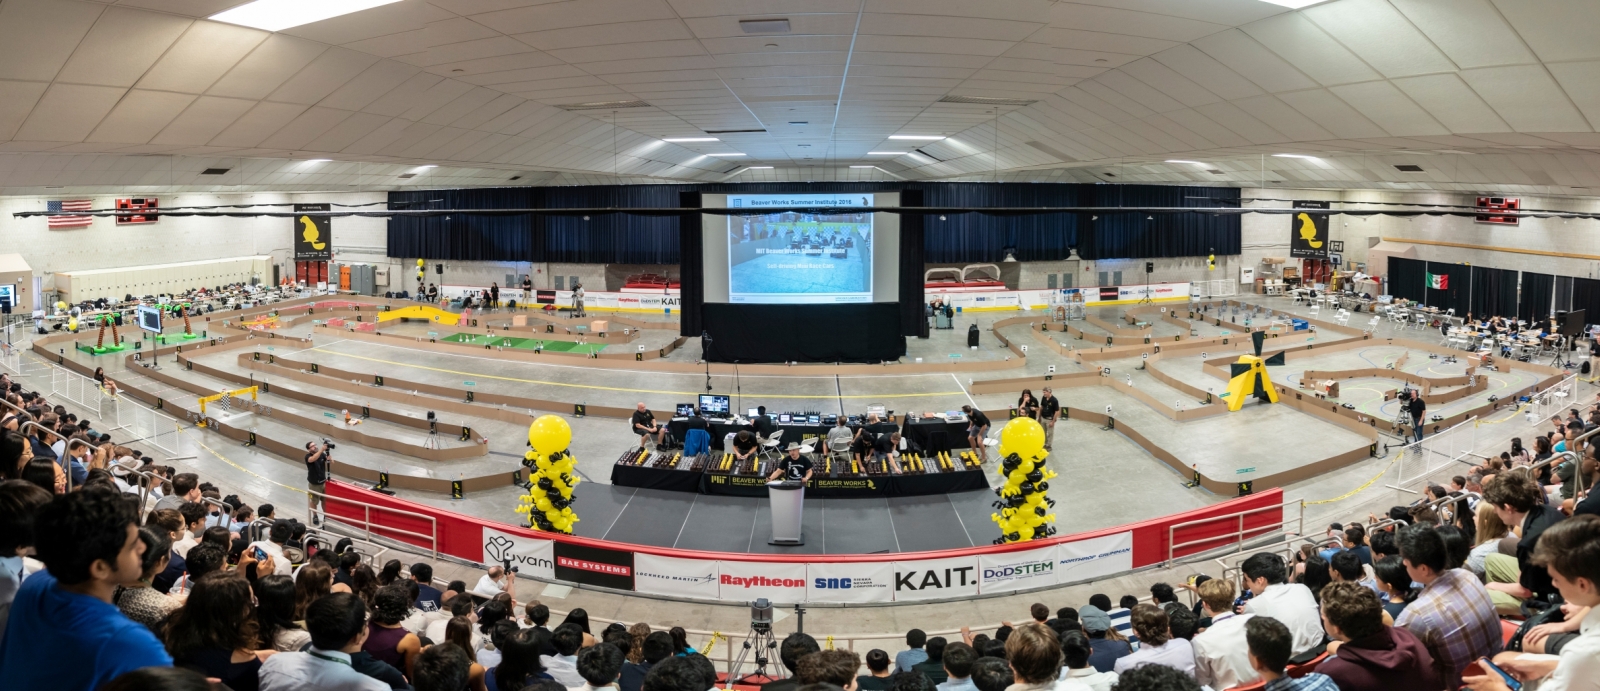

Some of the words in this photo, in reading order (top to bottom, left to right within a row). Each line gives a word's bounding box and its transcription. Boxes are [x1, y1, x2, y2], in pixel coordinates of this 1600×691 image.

[711, 475, 727, 484] MIT
[1060, 555, 1096, 564] NORTHROP
[1098, 548, 1130, 557] GRUMMAN
[561, 558, 579, 567] BAE
[582, 562, 627, 574] SYSTEMS
[984, 561, 1053, 578] DoDSTEM
[721, 574, 805, 588] Raytheon
[815, 578, 851, 589] snc
[895, 566, 977, 591] KAIT.
